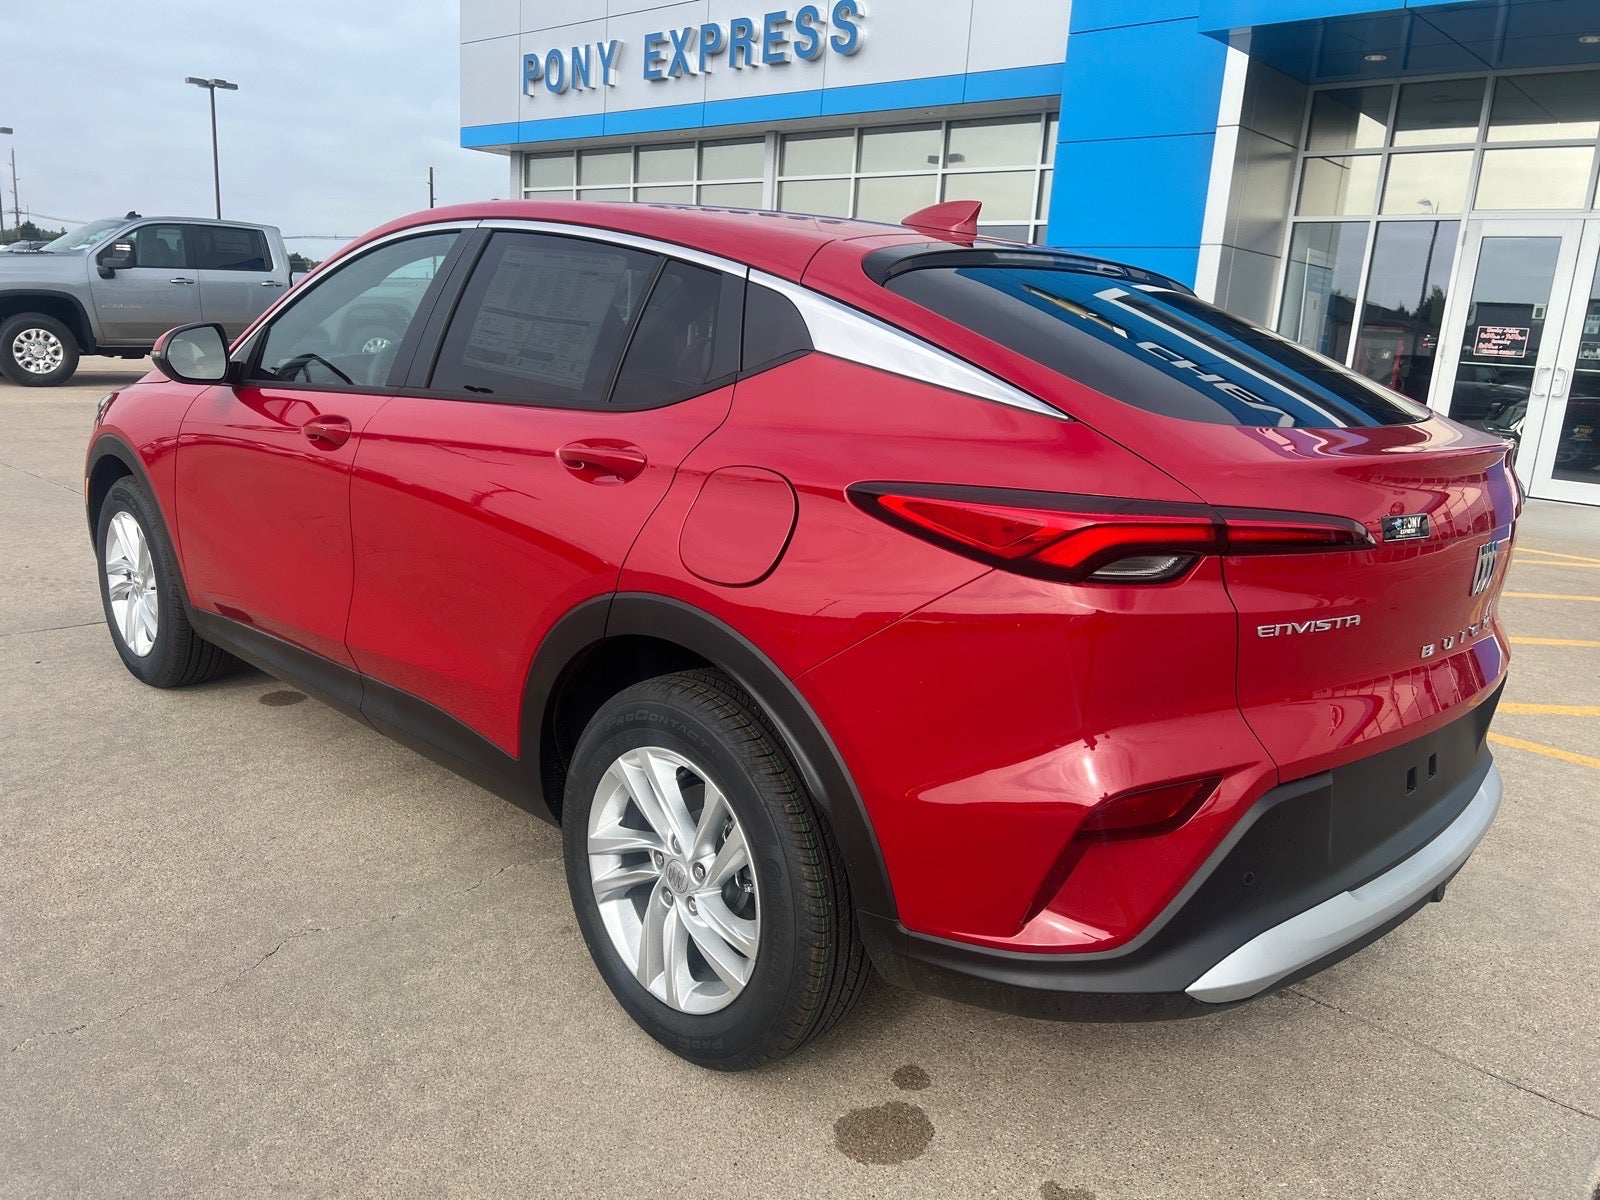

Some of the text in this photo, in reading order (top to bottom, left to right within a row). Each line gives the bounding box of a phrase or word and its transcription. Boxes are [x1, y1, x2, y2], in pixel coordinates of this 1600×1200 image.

[523, 0, 865, 96] PONY EXPRESS
[1403, 516, 1421, 528] PONY
[1257, 614, 1361, 637] ENVISTA
